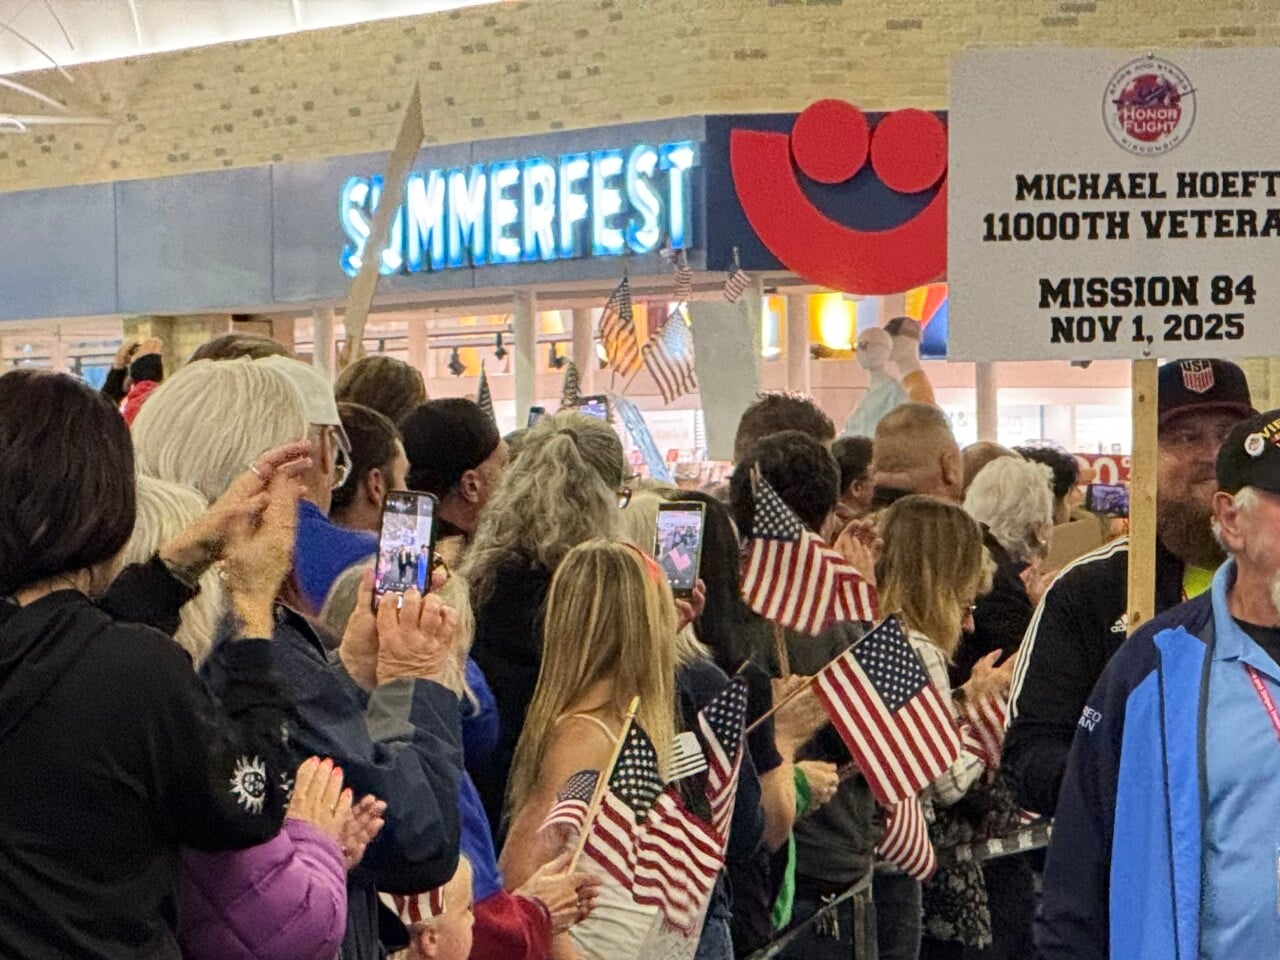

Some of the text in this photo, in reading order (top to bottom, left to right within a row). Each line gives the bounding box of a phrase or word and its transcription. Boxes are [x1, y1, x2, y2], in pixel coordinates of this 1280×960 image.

[1123, 107, 1178, 120] HONOR
[1123, 120, 1177, 133] FLIGHT
[1015, 172, 1167, 201] MICHAEL
[983, 211, 1131, 241] 11000TH
[1039, 275, 1257, 308] MISSION 84
[1050, 314, 1245, 345] NOV 1, 2025
